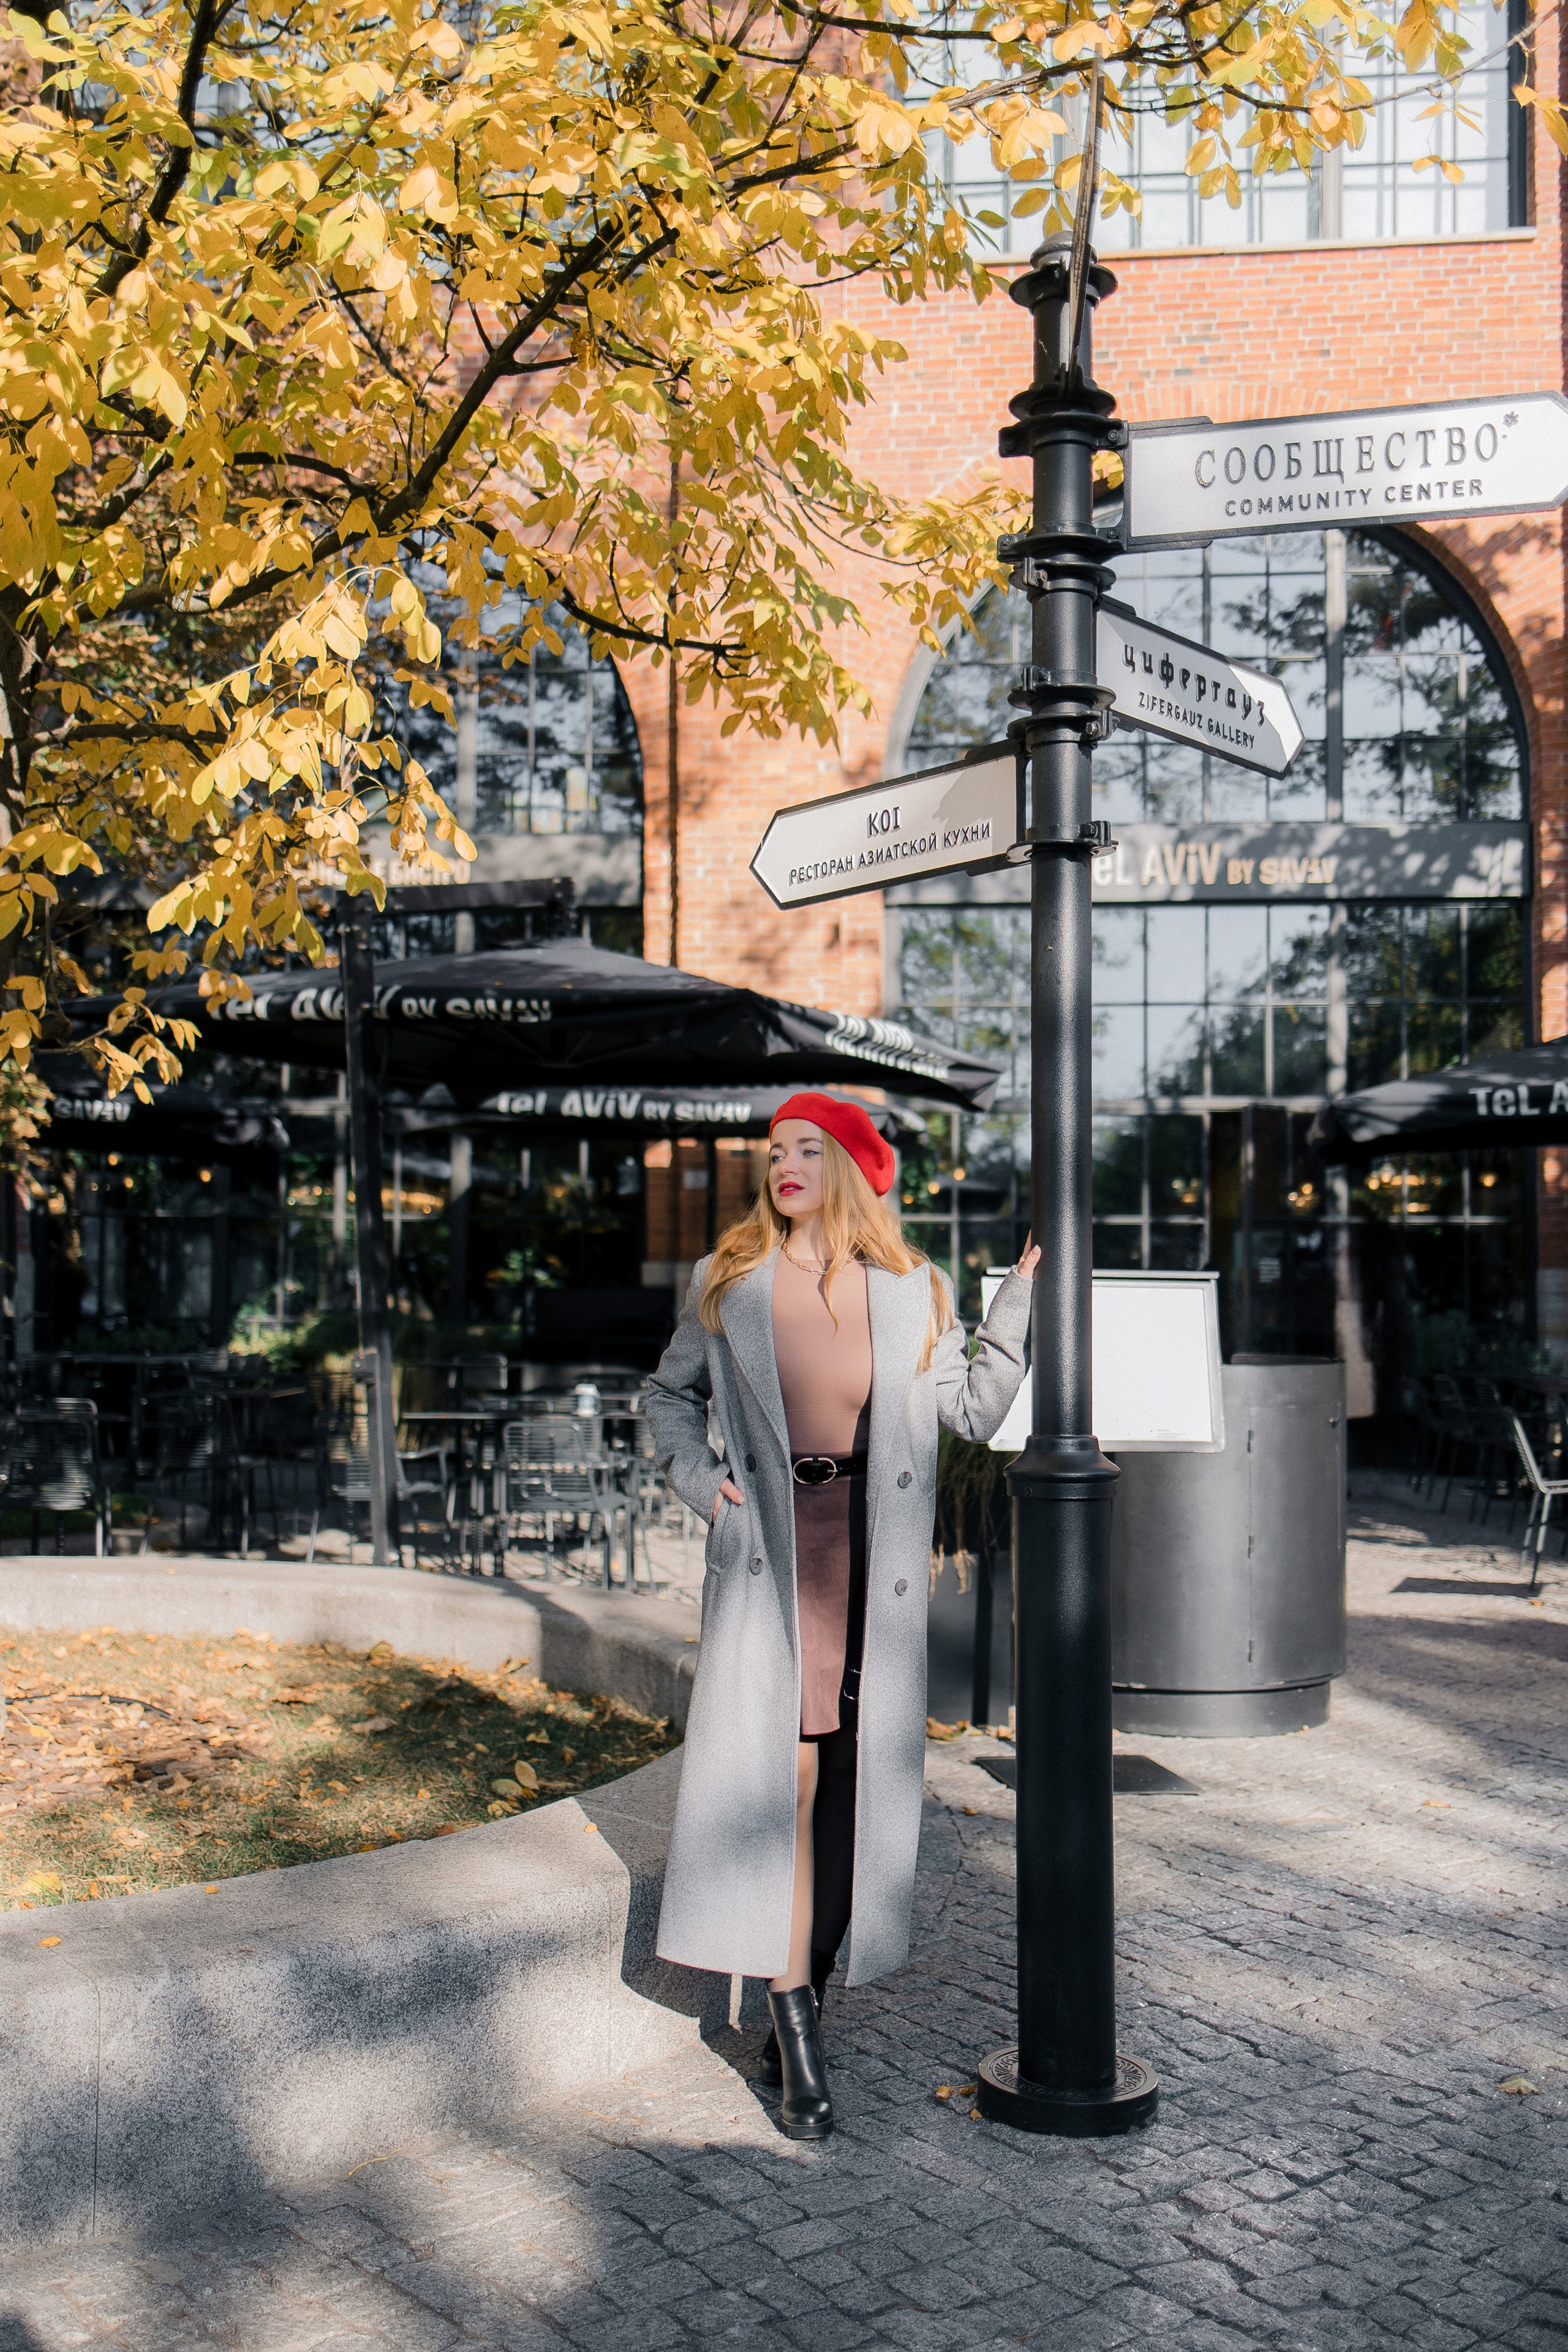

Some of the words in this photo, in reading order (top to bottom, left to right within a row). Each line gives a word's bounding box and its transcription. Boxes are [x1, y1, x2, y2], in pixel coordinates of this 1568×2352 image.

[1225, 488, 1373, 516] COMMUNITY
[1385, 478, 1483, 502] CENTER
[1138, 691, 1203, 729] ZIFERGAUZ
[1207, 718, 1255, 750] GALLERY
[867, 805, 901, 837] KOI
[790, 855, 854, 884] РЕСТОРАН
[858, 831, 937, 867] АЗИАТСКОЙ
[943, 822, 990, 848] КУХНИ
[1227, 858, 1256, 886] BY
